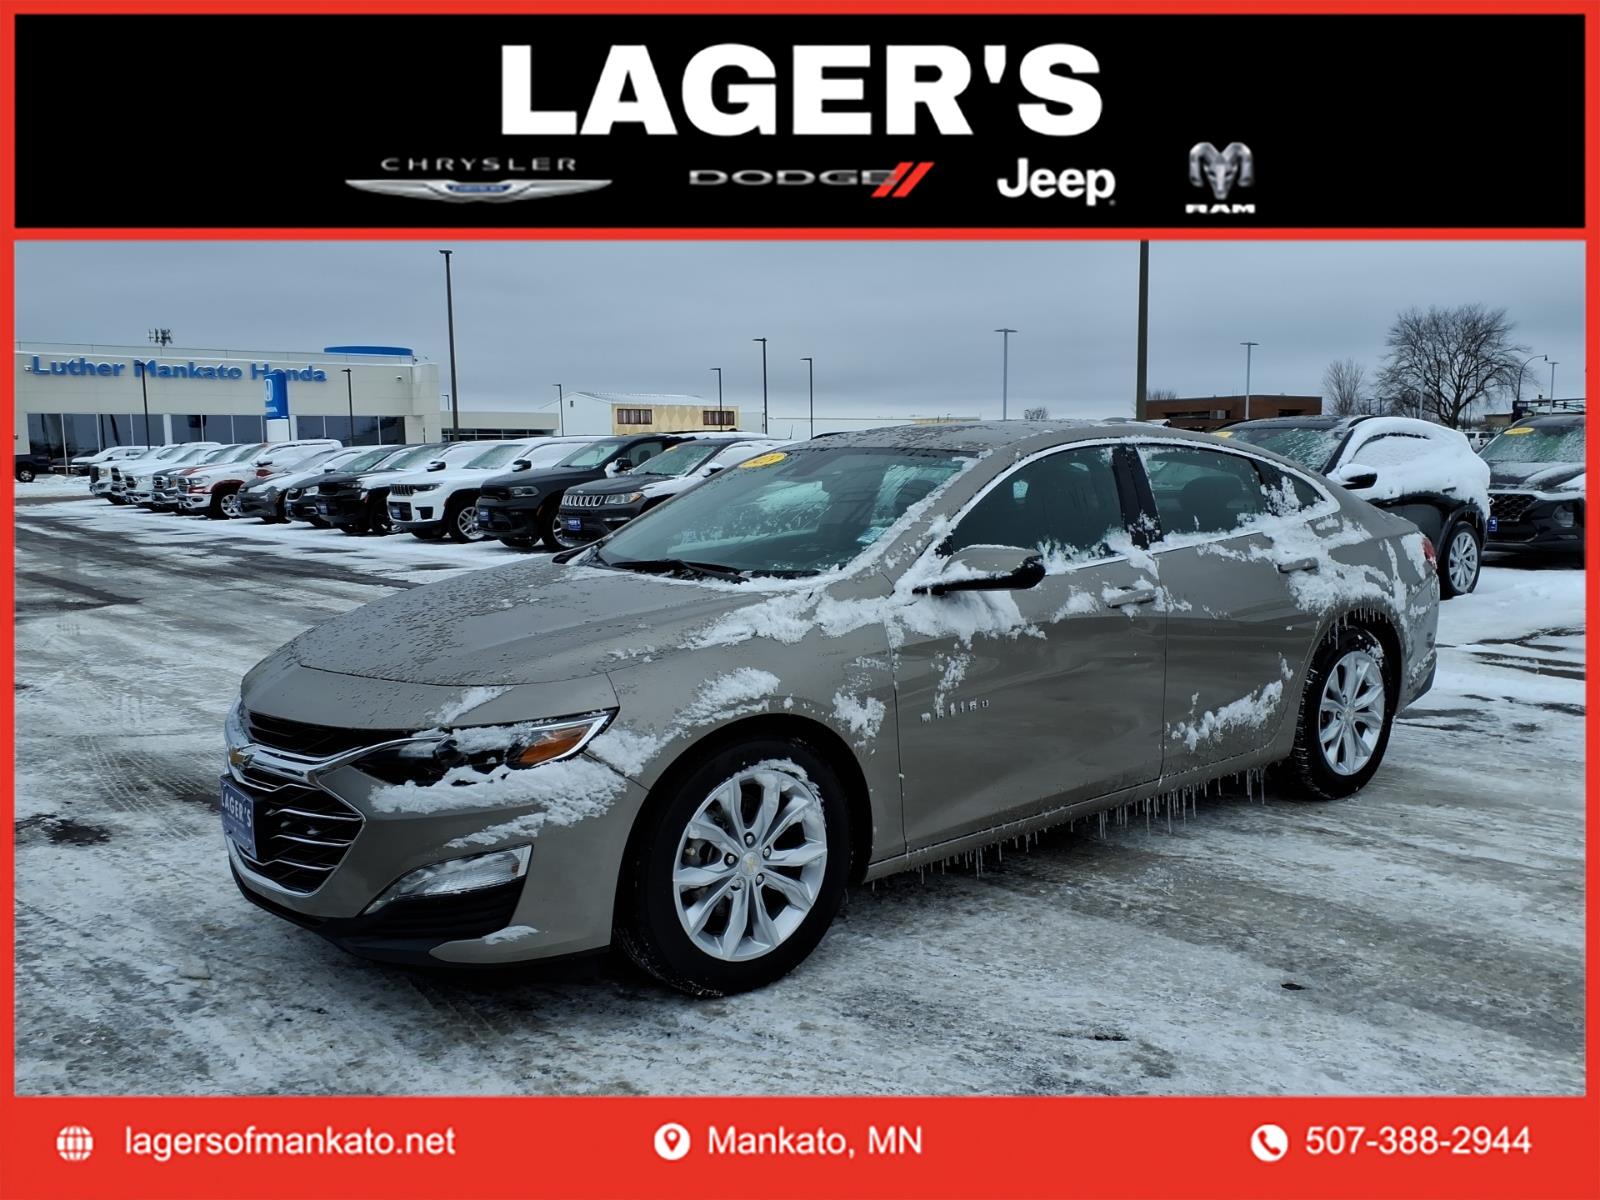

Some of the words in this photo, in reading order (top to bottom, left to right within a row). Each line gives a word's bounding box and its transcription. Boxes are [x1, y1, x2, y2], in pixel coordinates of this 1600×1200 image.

[32, 355, 125, 378] Luther
[134, 359, 243, 380] Mankato
[220, 789, 252, 828] LAGER'S
